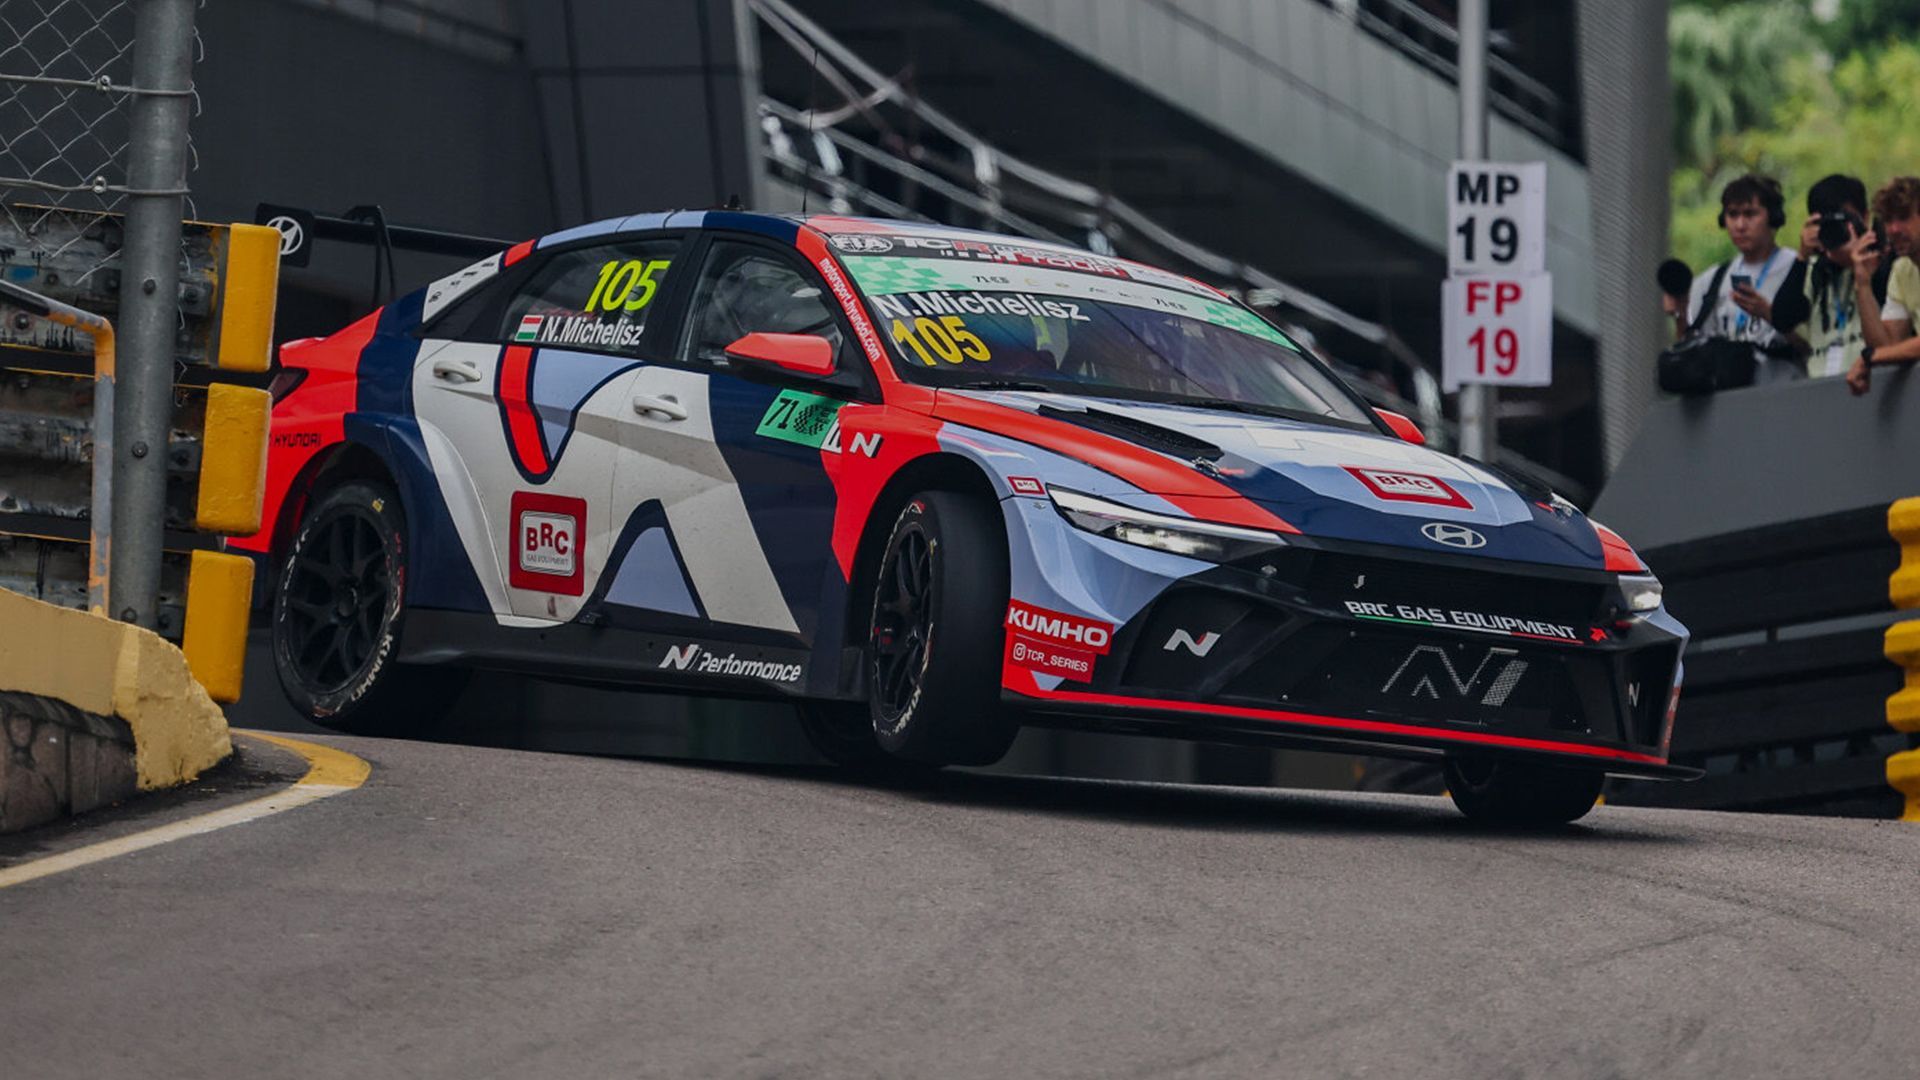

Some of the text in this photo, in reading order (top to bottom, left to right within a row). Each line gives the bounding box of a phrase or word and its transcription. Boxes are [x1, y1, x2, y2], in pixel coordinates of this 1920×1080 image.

[1456, 173, 1520, 204] MP
[836, 236, 992, 254] FIA TCR
[1456, 216, 1519, 264] 19
[584, 260, 671, 313] 105
[1466, 281, 1522, 316] FP
[819, 258, 881, 362] motorsport.hyundai.com
[872, 291, 1091, 322] N.Michelisz
[541, 316, 644, 346] N.Michelisz
[892, 316, 992, 366] 105
[1467, 326, 1519, 377] 19
[765, 398, 800, 430] 71
[275, 433, 321, 448] HYUNDAI
[1375, 475, 1434, 490] BRC
[526, 522, 569, 556] BRC
[1008, 607, 1109, 648] KUMHO
[1345, 601, 1577, 639] BRC GAS EQUIPMENT
[698, 652, 801, 681] Performance
[1026, 649, 1089, 673] TCR_SERIES
